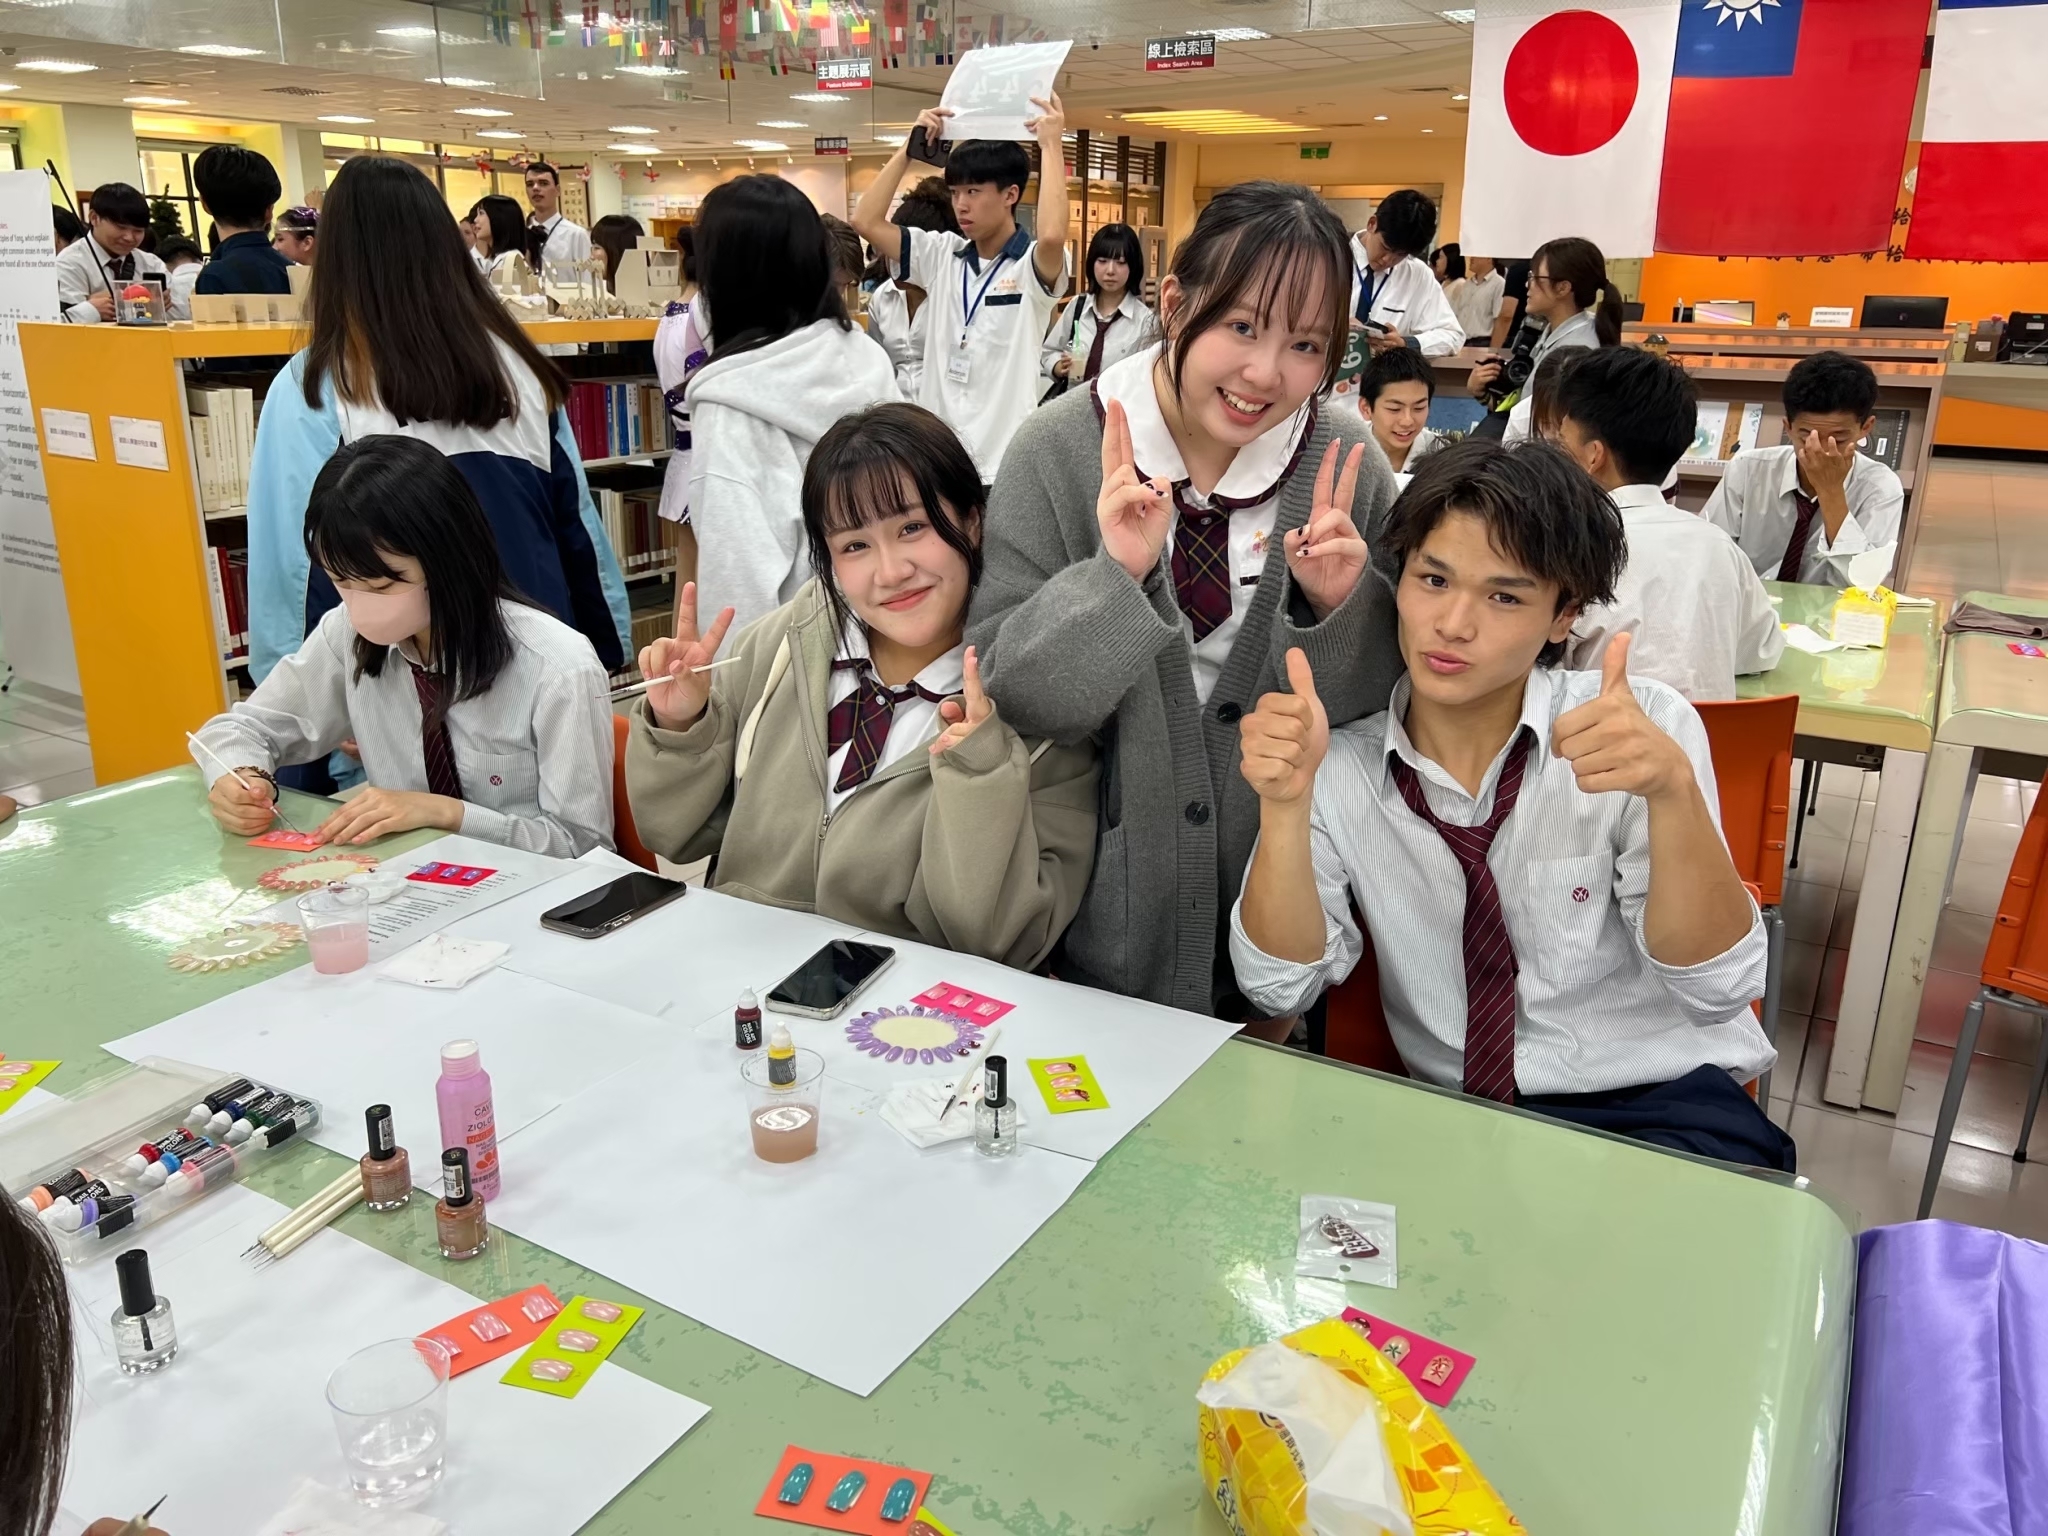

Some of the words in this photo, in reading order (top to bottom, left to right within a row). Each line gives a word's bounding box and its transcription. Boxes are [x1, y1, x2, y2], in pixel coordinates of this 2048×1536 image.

[1148, 40, 1213, 59] 線上檢索區
[818, 64, 871, 80] 主題展示區
[75, 1192, 89, 1203] NAIL
[87, 1183, 99, 1194] ART
